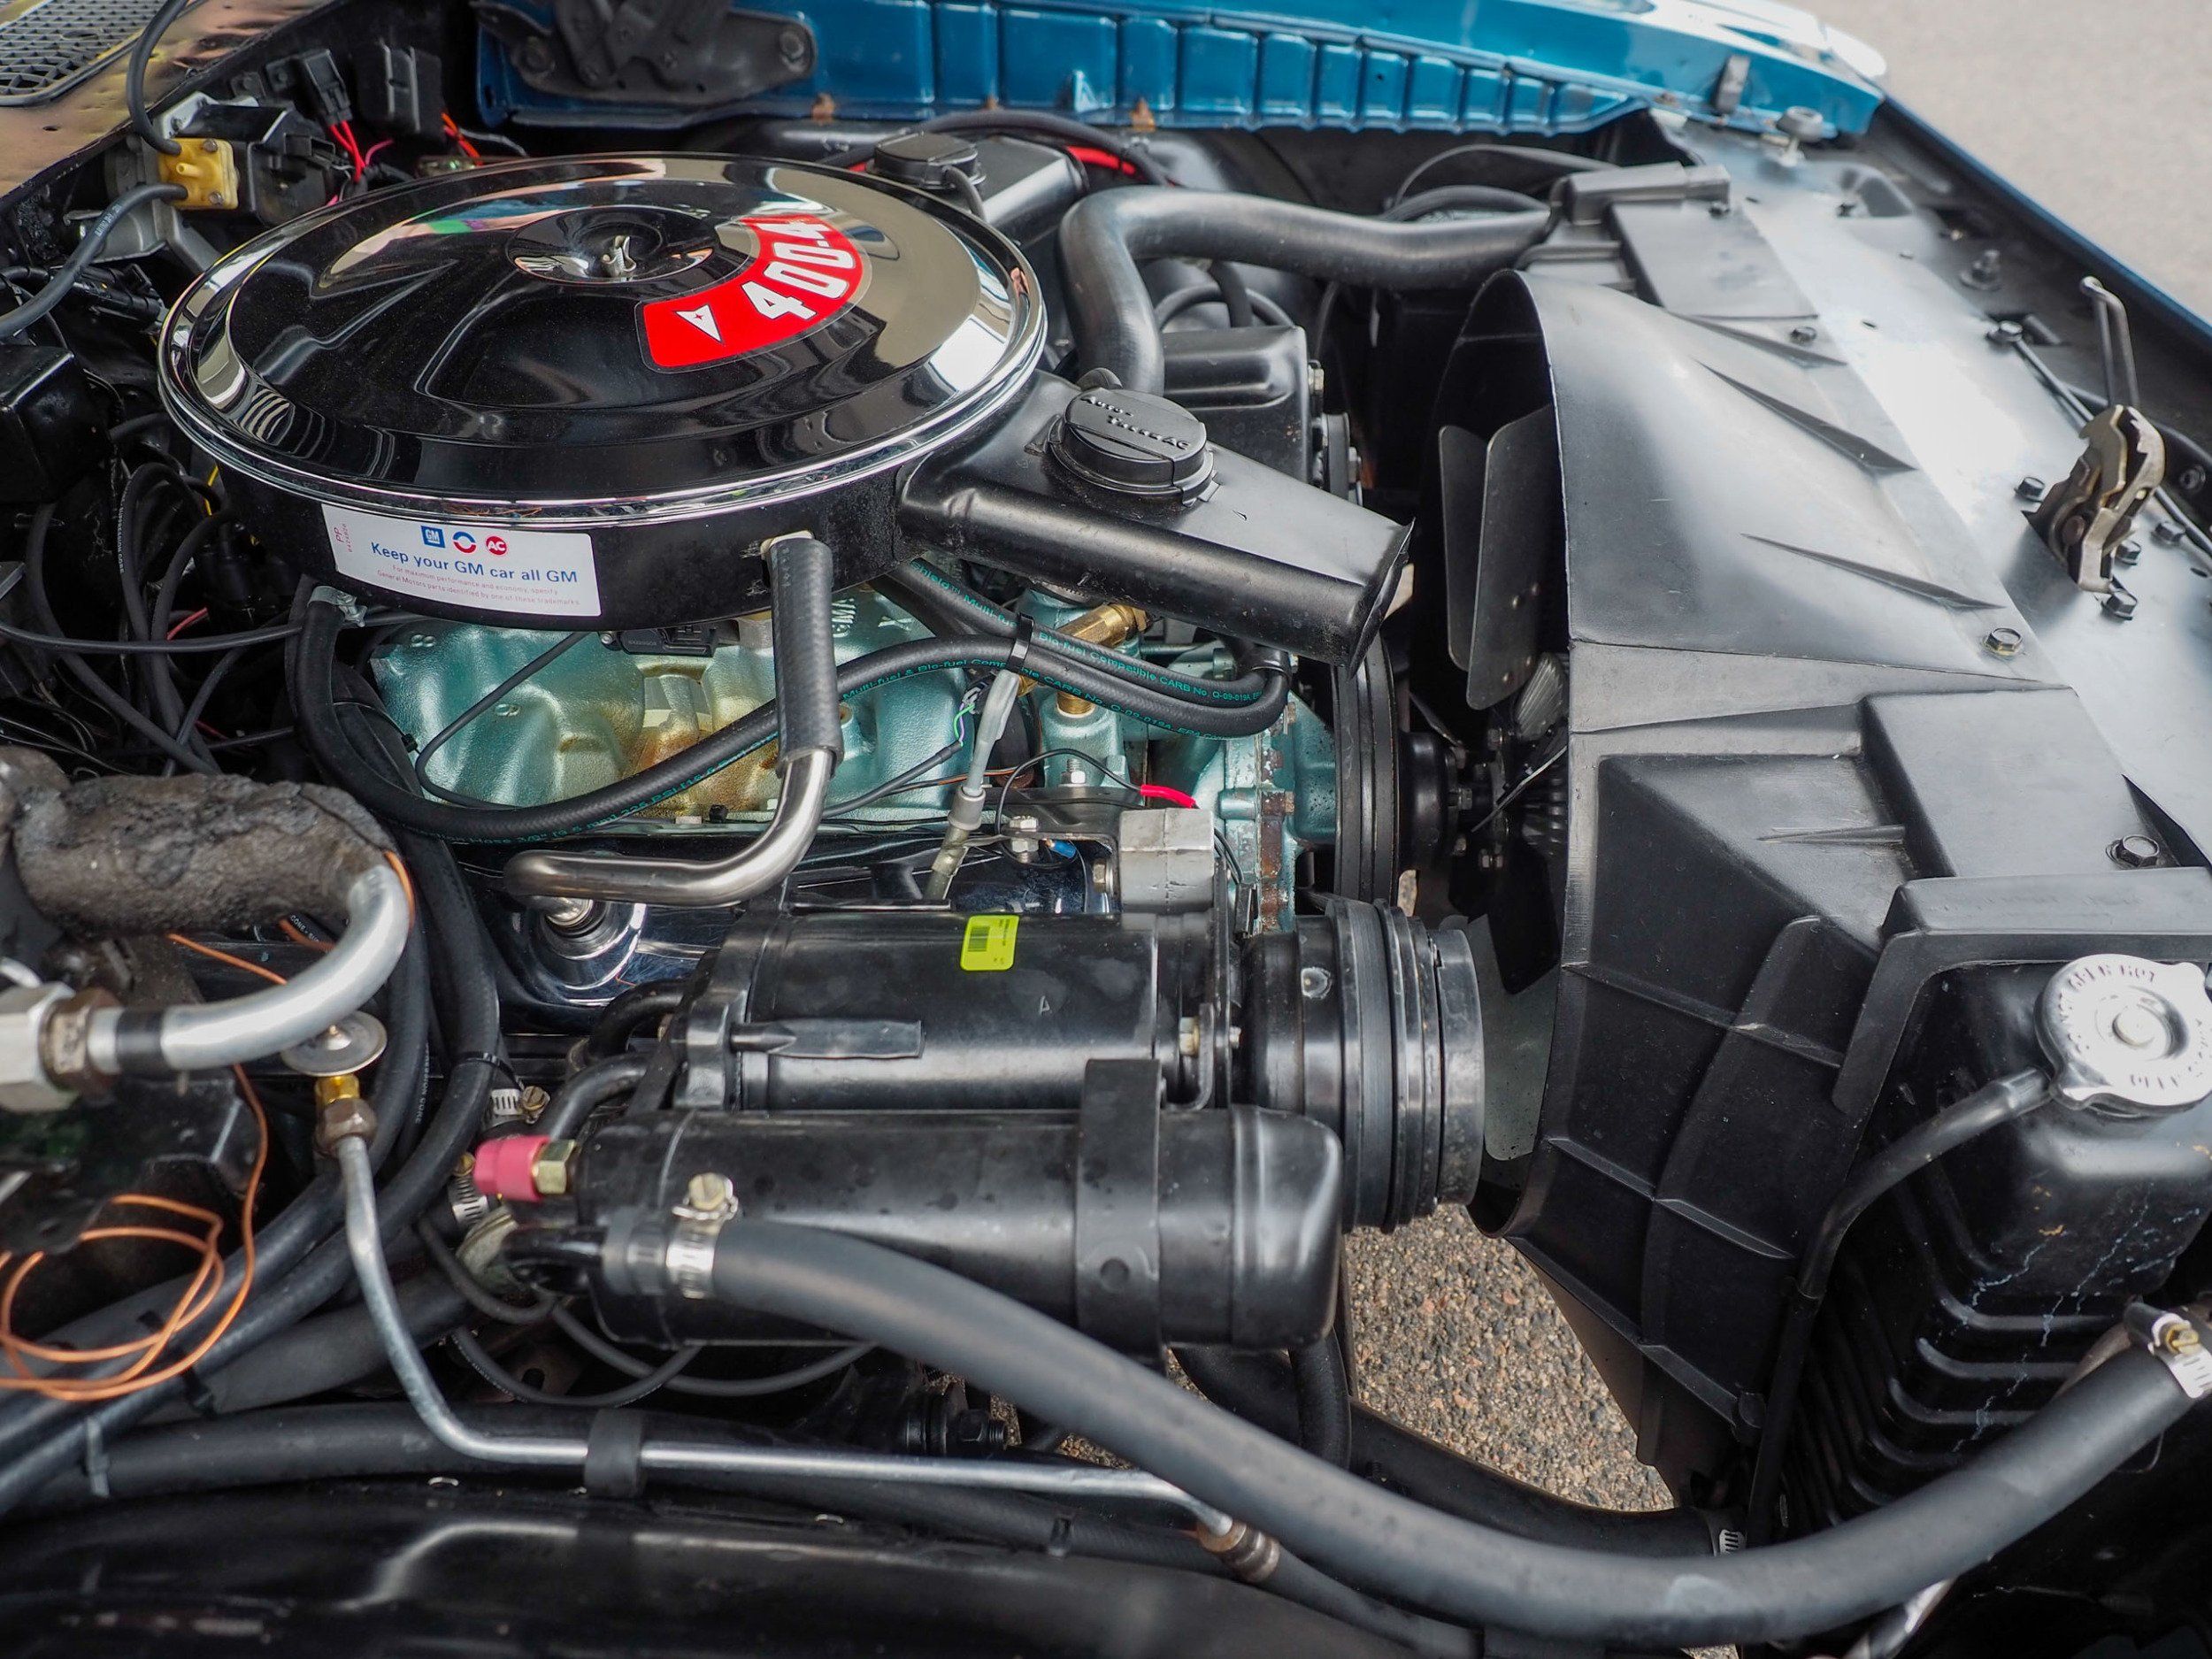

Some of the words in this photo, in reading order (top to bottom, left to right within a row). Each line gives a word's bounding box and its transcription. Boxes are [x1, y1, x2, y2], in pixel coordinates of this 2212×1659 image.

[371, 541, 409, 565] Keep
[413, 555, 449, 571] your
[454, 560, 484, 576] GM
[489, 568, 514, 580] car
[521, 569, 541, 581] all
[546, 570, 578, 583] GM
[488, 539, 506, 551] AC
[964, 594, 1018, 628] Multi-fue
[842, 672, 901, 700] Multi-fuel
[918, 659, 967, 672] Bio-fuel
[1043, 676, 1082, 696] CARB
[1039, 632, 1086, 657] Bio-fuel
[1090, 652, 1156, 680] Compatible
[1159, 676, 1191, 692] CARB
